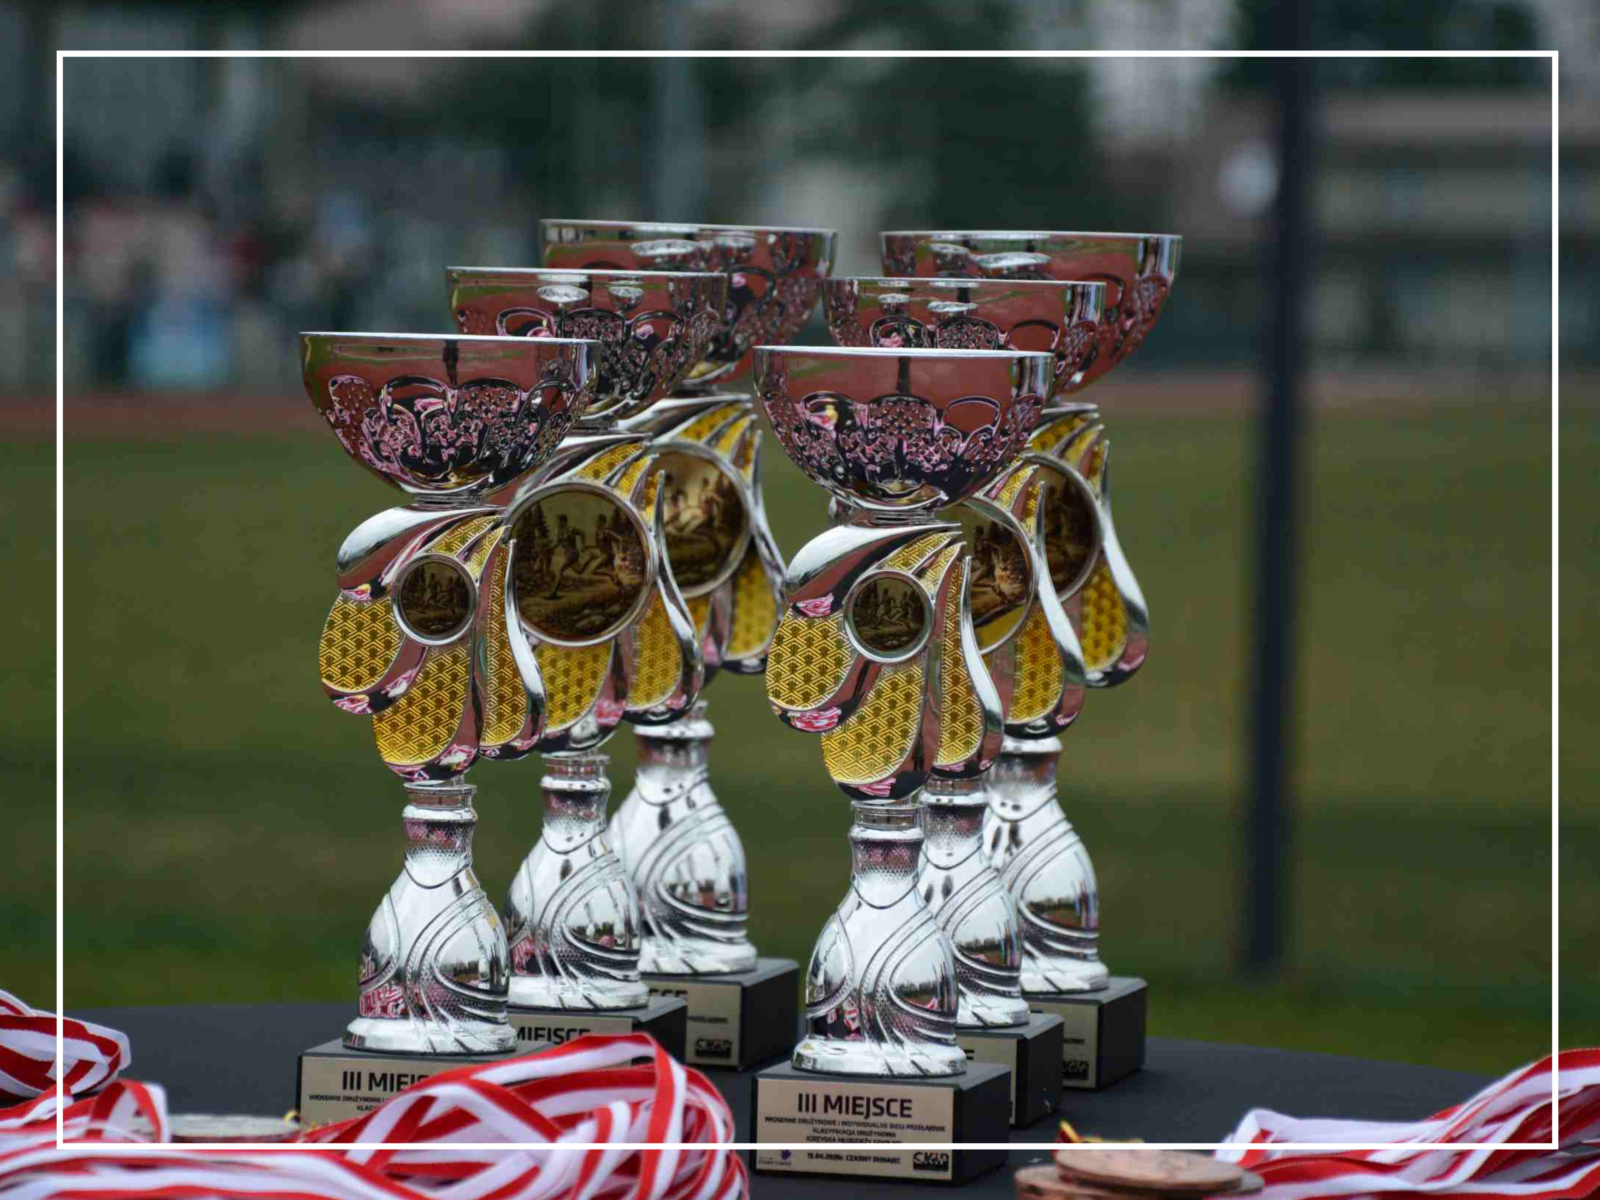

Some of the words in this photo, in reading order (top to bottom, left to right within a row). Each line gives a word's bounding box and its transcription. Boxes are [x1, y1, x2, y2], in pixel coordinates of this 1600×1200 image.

[342, 1071, 361, 1091] III
[797, 1093, 817, 1113] III
[823, 1095, 913, 1120] MIEJSCE
[812, 1127, 856, 1137] KLASYFIKACJA
[845, 1154, 872, 1162] CZARNY
